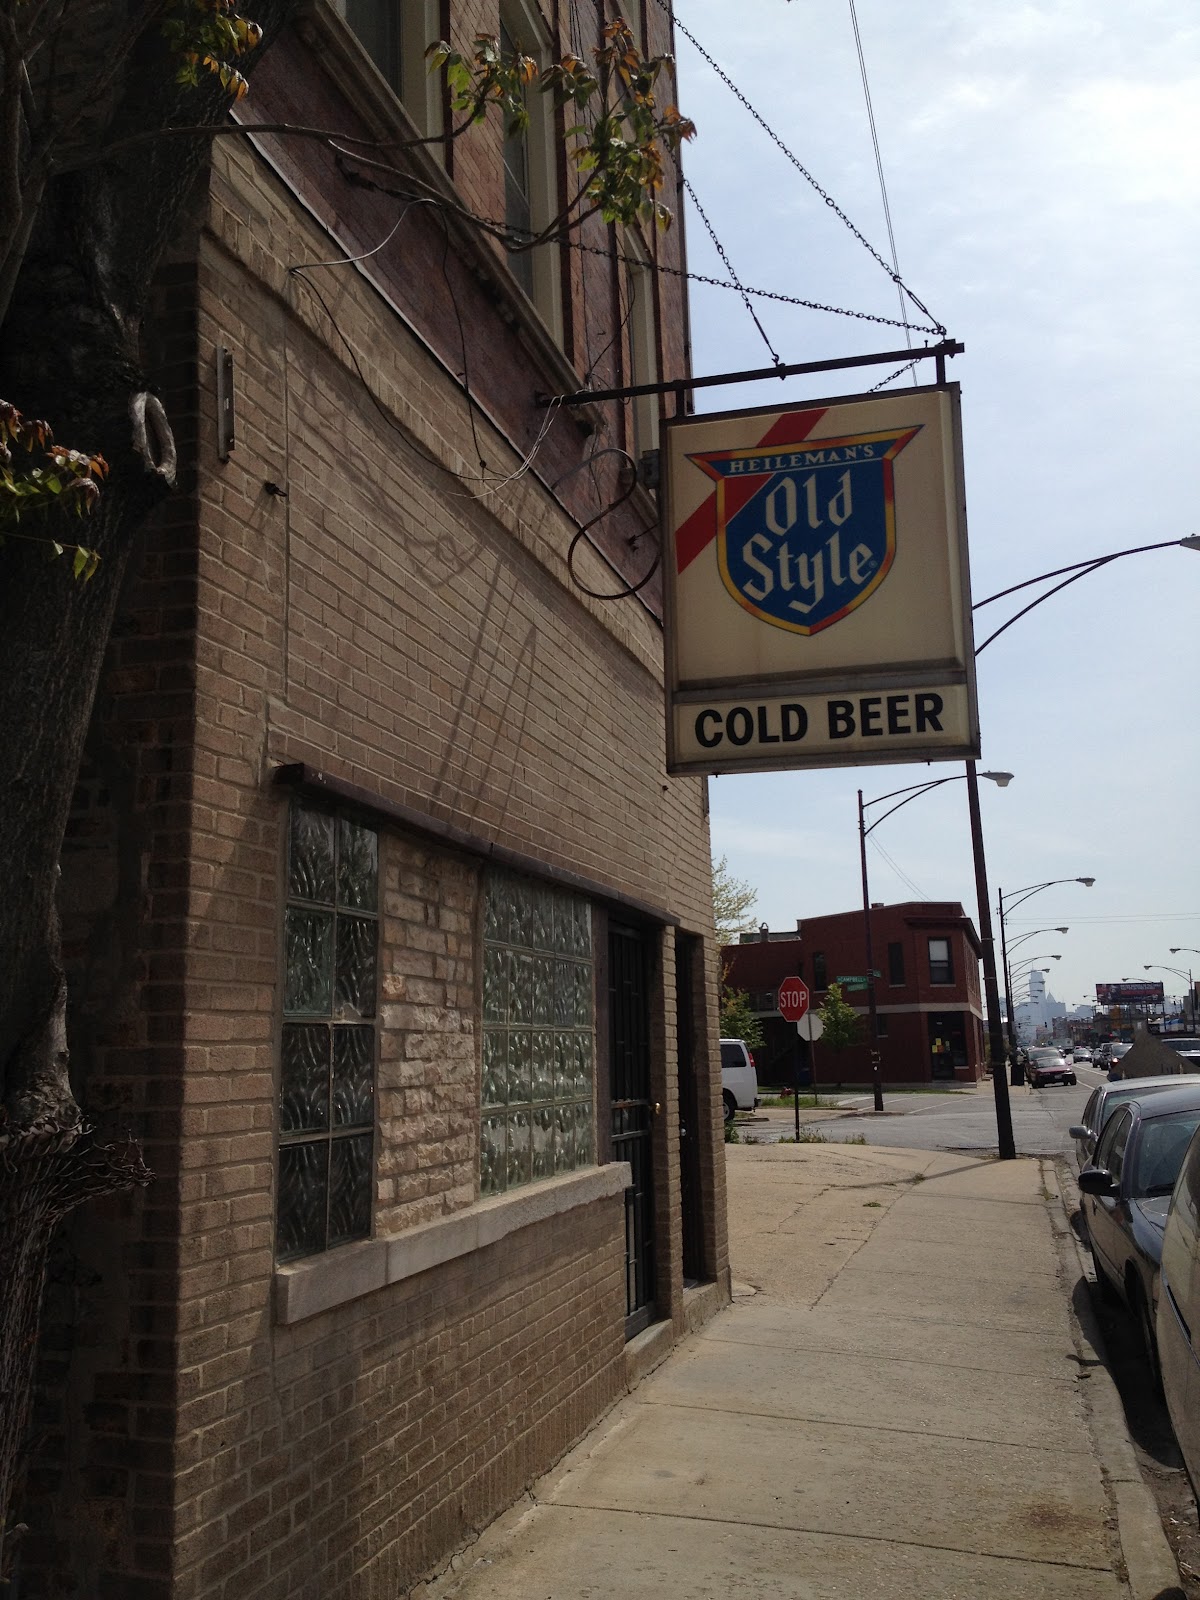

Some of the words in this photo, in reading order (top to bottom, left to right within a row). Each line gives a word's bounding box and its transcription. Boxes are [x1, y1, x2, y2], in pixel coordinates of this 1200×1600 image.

[729, 444, 874, 473] HEILEMAN'S
[765, 468, 853, 536] Old
[742, 531, 874, 614] Style
[695, 703, 808, 748] COLD
[827, 692, 944, 739] BEER
[780, 991, 807, 1008] STOP
